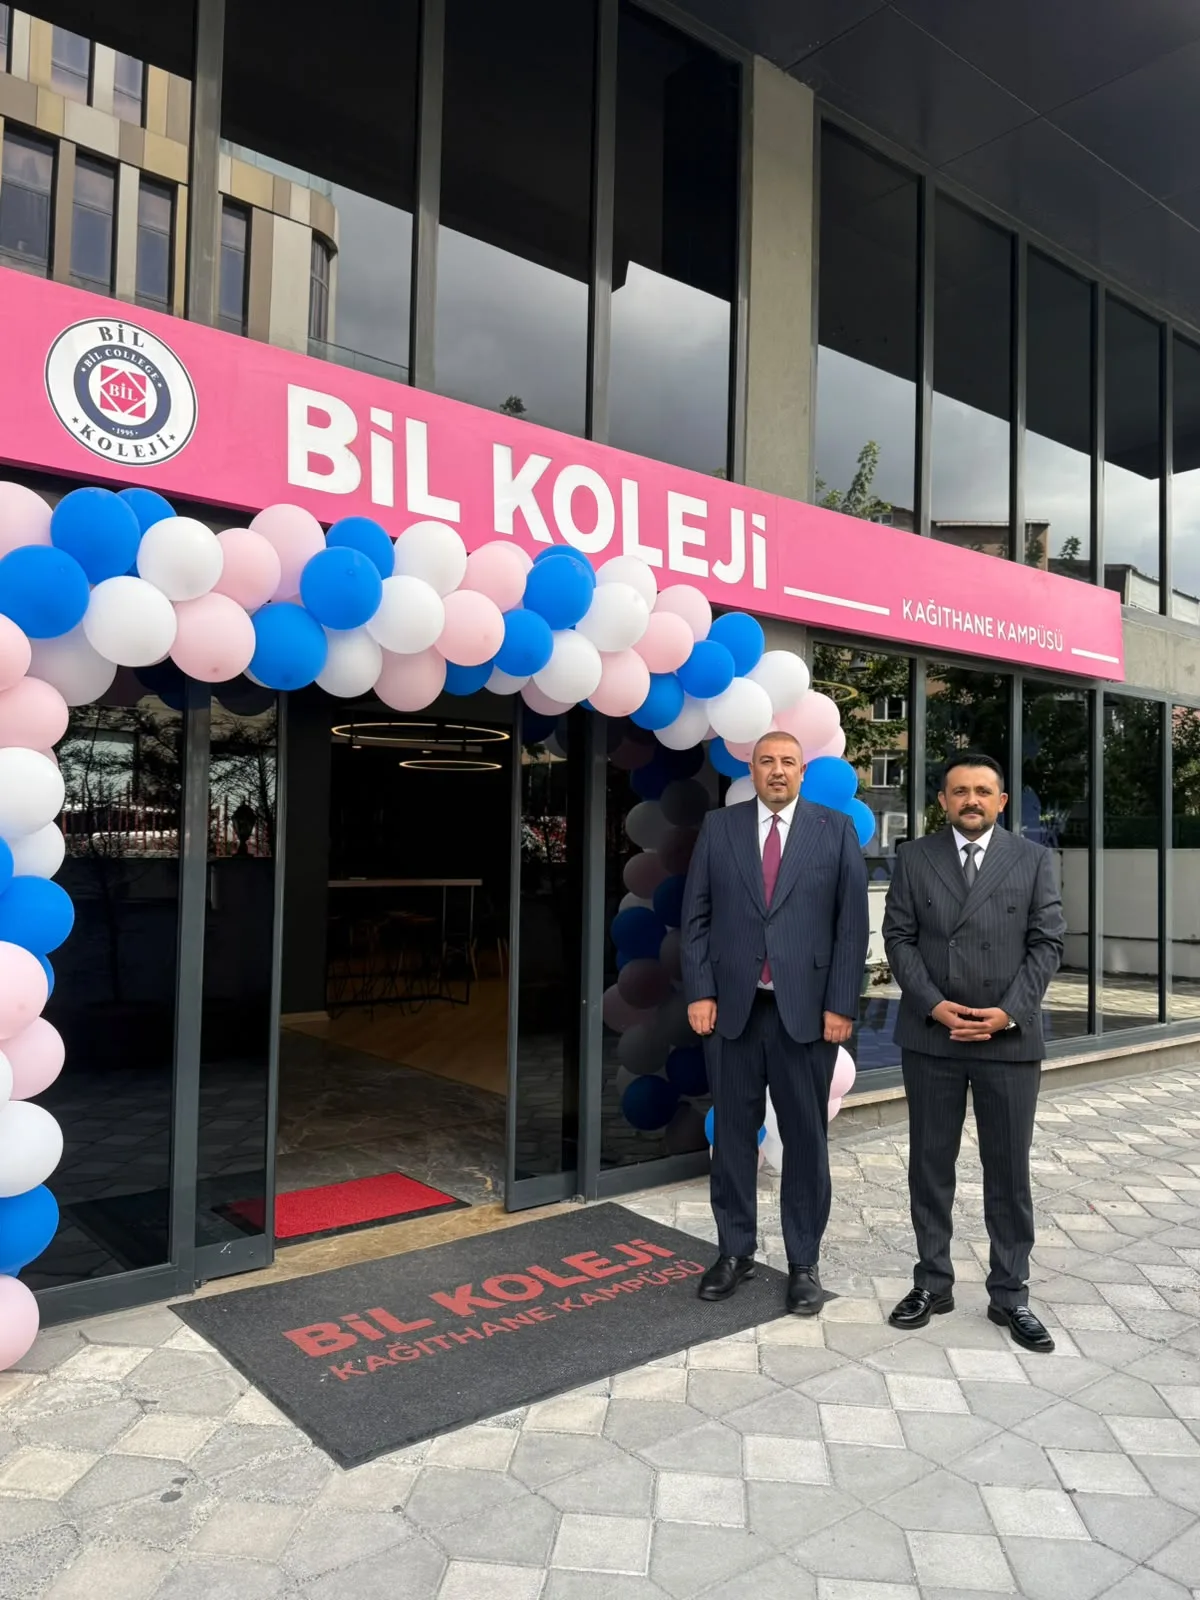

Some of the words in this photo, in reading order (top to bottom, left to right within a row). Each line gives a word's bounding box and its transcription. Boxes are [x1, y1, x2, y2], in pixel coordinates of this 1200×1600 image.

[105, 348, 159, 381] COLLEGE
[116, 428, 135, 437] 1995
[902, 598, 994, 638] KAĞITHANE
[997, 618, 1064, 652] KAMPÜSÜ
[329, 1306, 557, 1381] KAĞITHANE
[556, 1259, 706, 1312] KAMPÜSÜ
